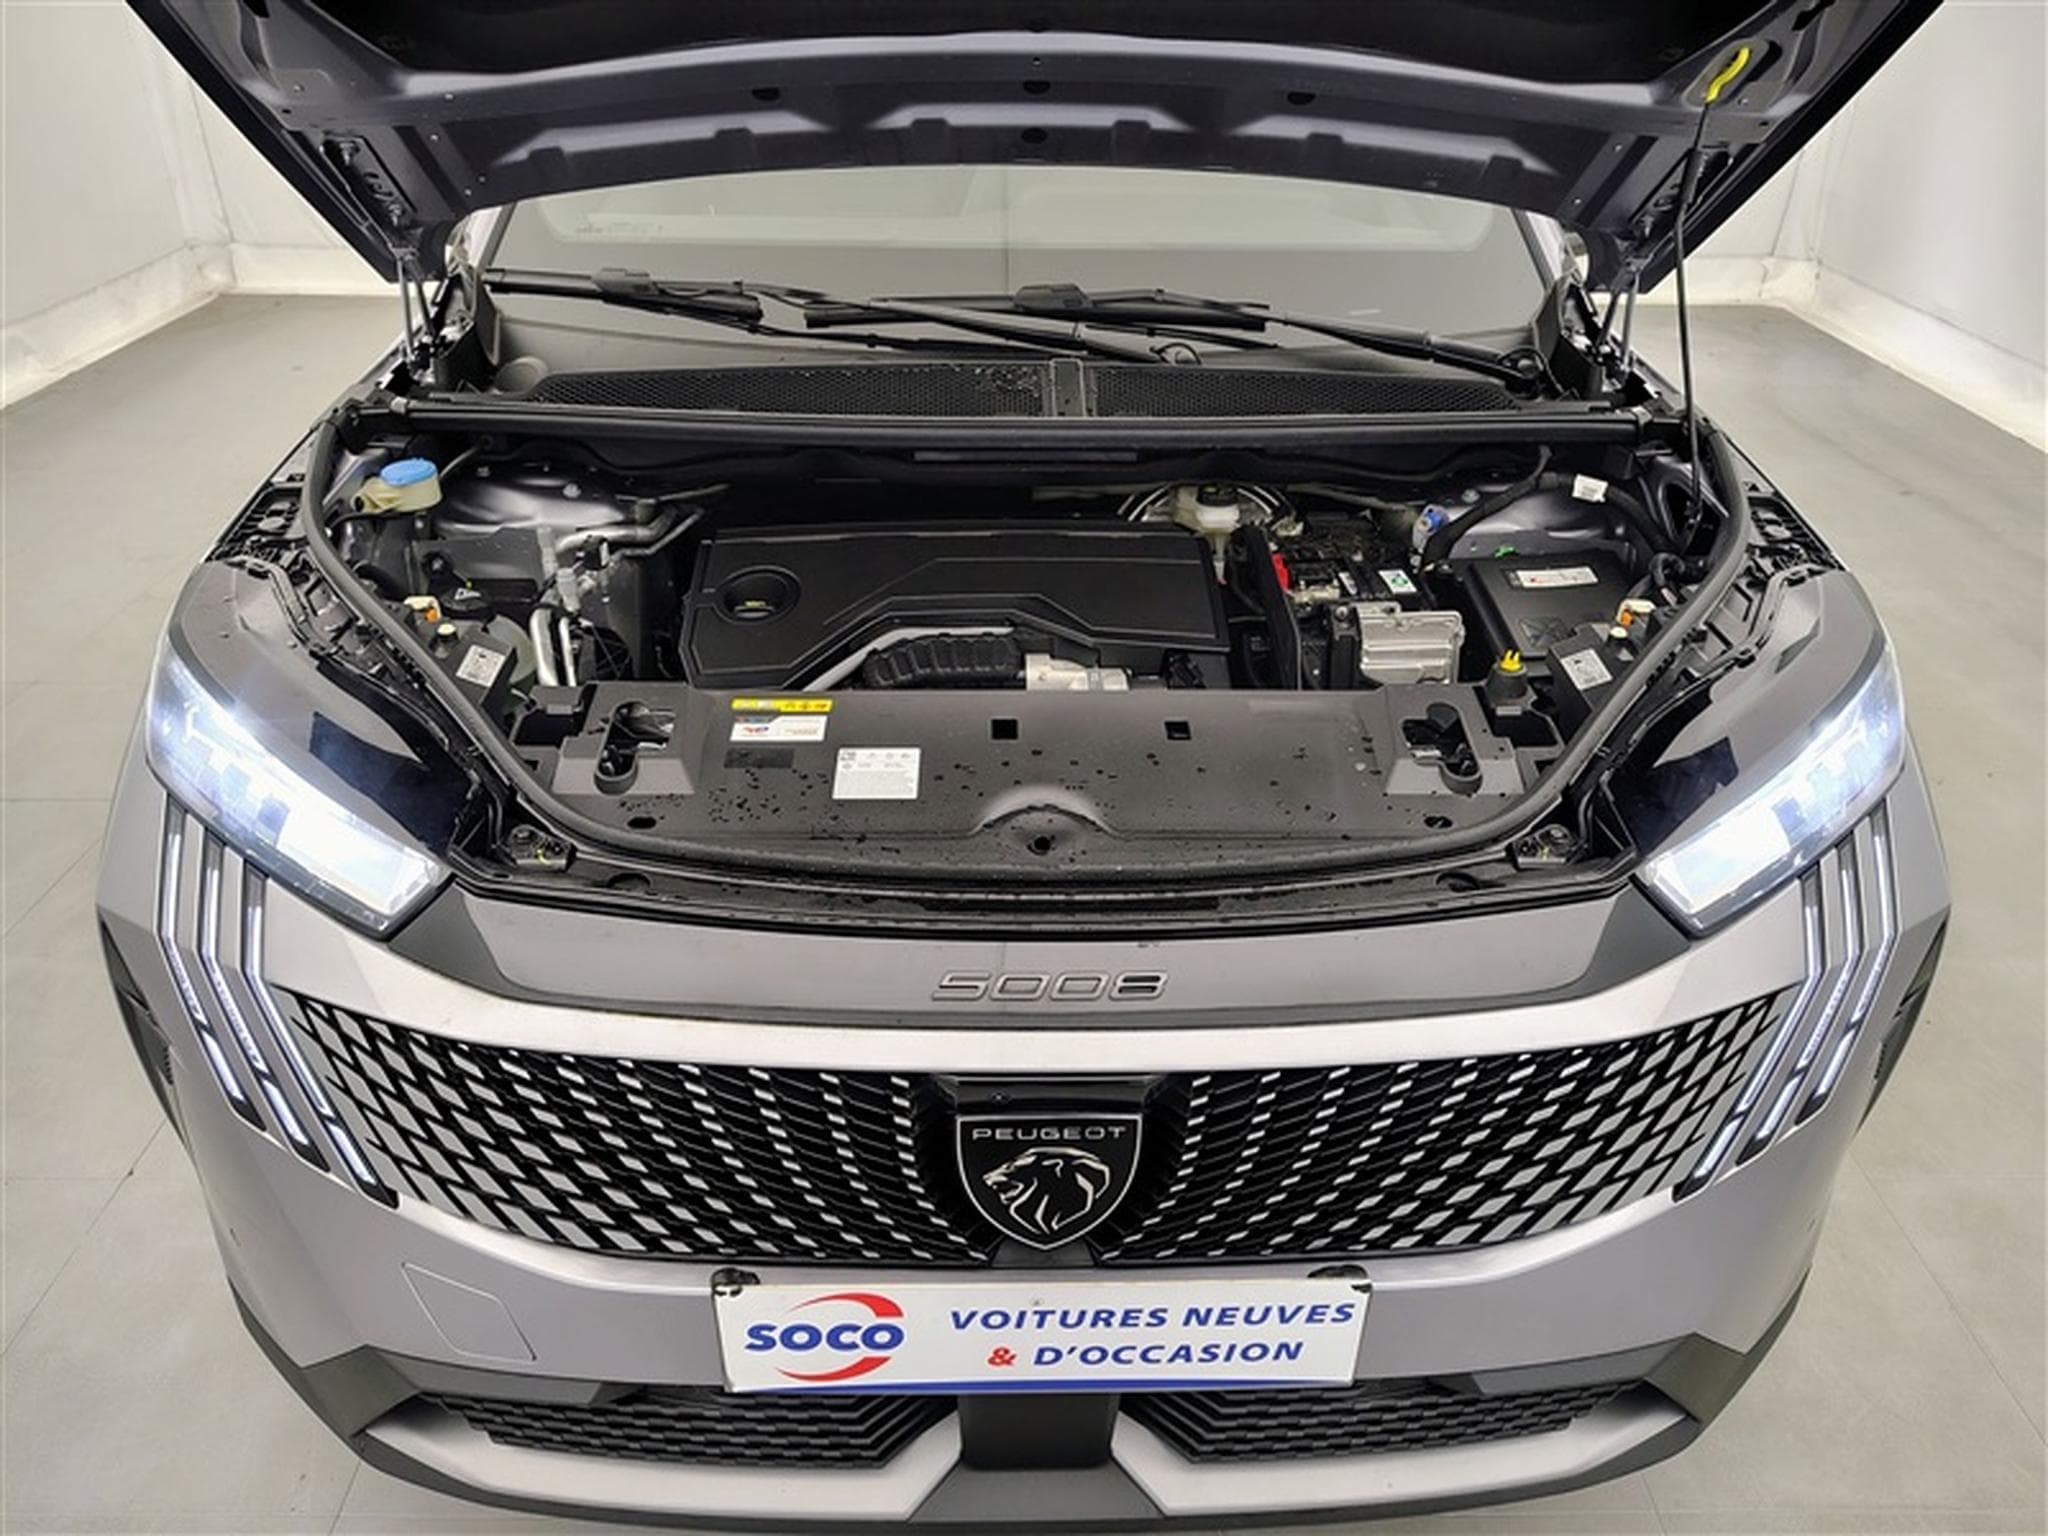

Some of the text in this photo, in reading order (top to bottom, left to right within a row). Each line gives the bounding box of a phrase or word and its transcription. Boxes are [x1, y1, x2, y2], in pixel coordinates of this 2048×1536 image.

[931, 971, 1167, 1001] 5008
[972, 1125, 1127, 1141] PEUGEOT
[950, 1303, 1355, 1331] VOITURES NEUVES
[744, 1322, 906, 1353] SOCO
[987, 1341, 1304, 1367] & D'OCCASION
